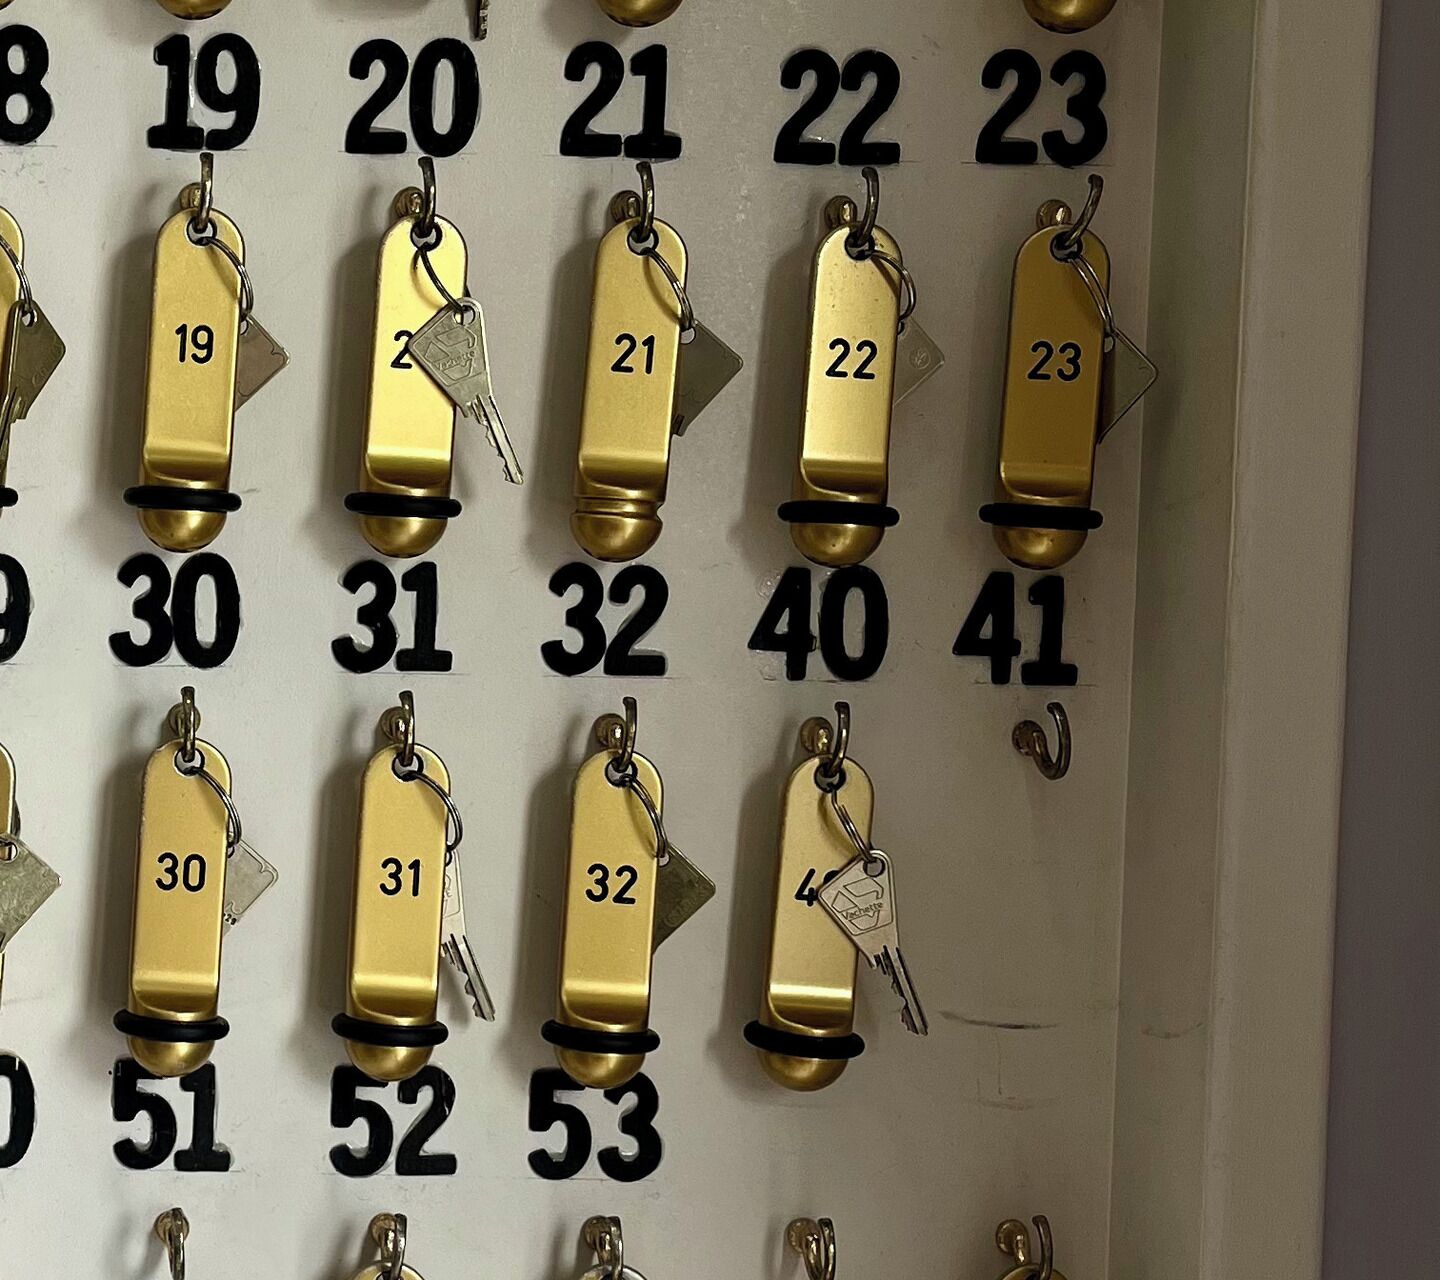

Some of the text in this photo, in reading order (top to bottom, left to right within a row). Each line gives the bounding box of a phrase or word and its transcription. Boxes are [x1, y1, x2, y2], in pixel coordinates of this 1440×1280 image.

[148, 32, 261, 151] 19
[344, 36, 480, 157] 20
[559, 41, 683, 160] 21
[773, 47, 901, 166] 22
[976, 48, 1108, 167] 23
[174, 324, 214, 364] 19
[390, 329, 414, 370] 2
[610, 333, 655, 375] 21
[825, 339, 877, 380] 22
[1028, 341, 1082, 382] 23
[109, 552, 240, 668] 30
[331, 561, 452, 674] 31
[540, 562, 669, 677] 32
[748, 565, 889, 681] 40
[953, 571, 1078, 686] 41
[155, 853, 206, 893] 30
[379, 858, 422, 898] 31
[584, 864, 637, 906] 32
[793, 867, 839, 907] 4
[842, 901, 886, 921] Vachette
[112, 1056, 231, 1172] 51
[330, 1064, 457, 1177] 52
[528, 1067, 663, 1182] 53
